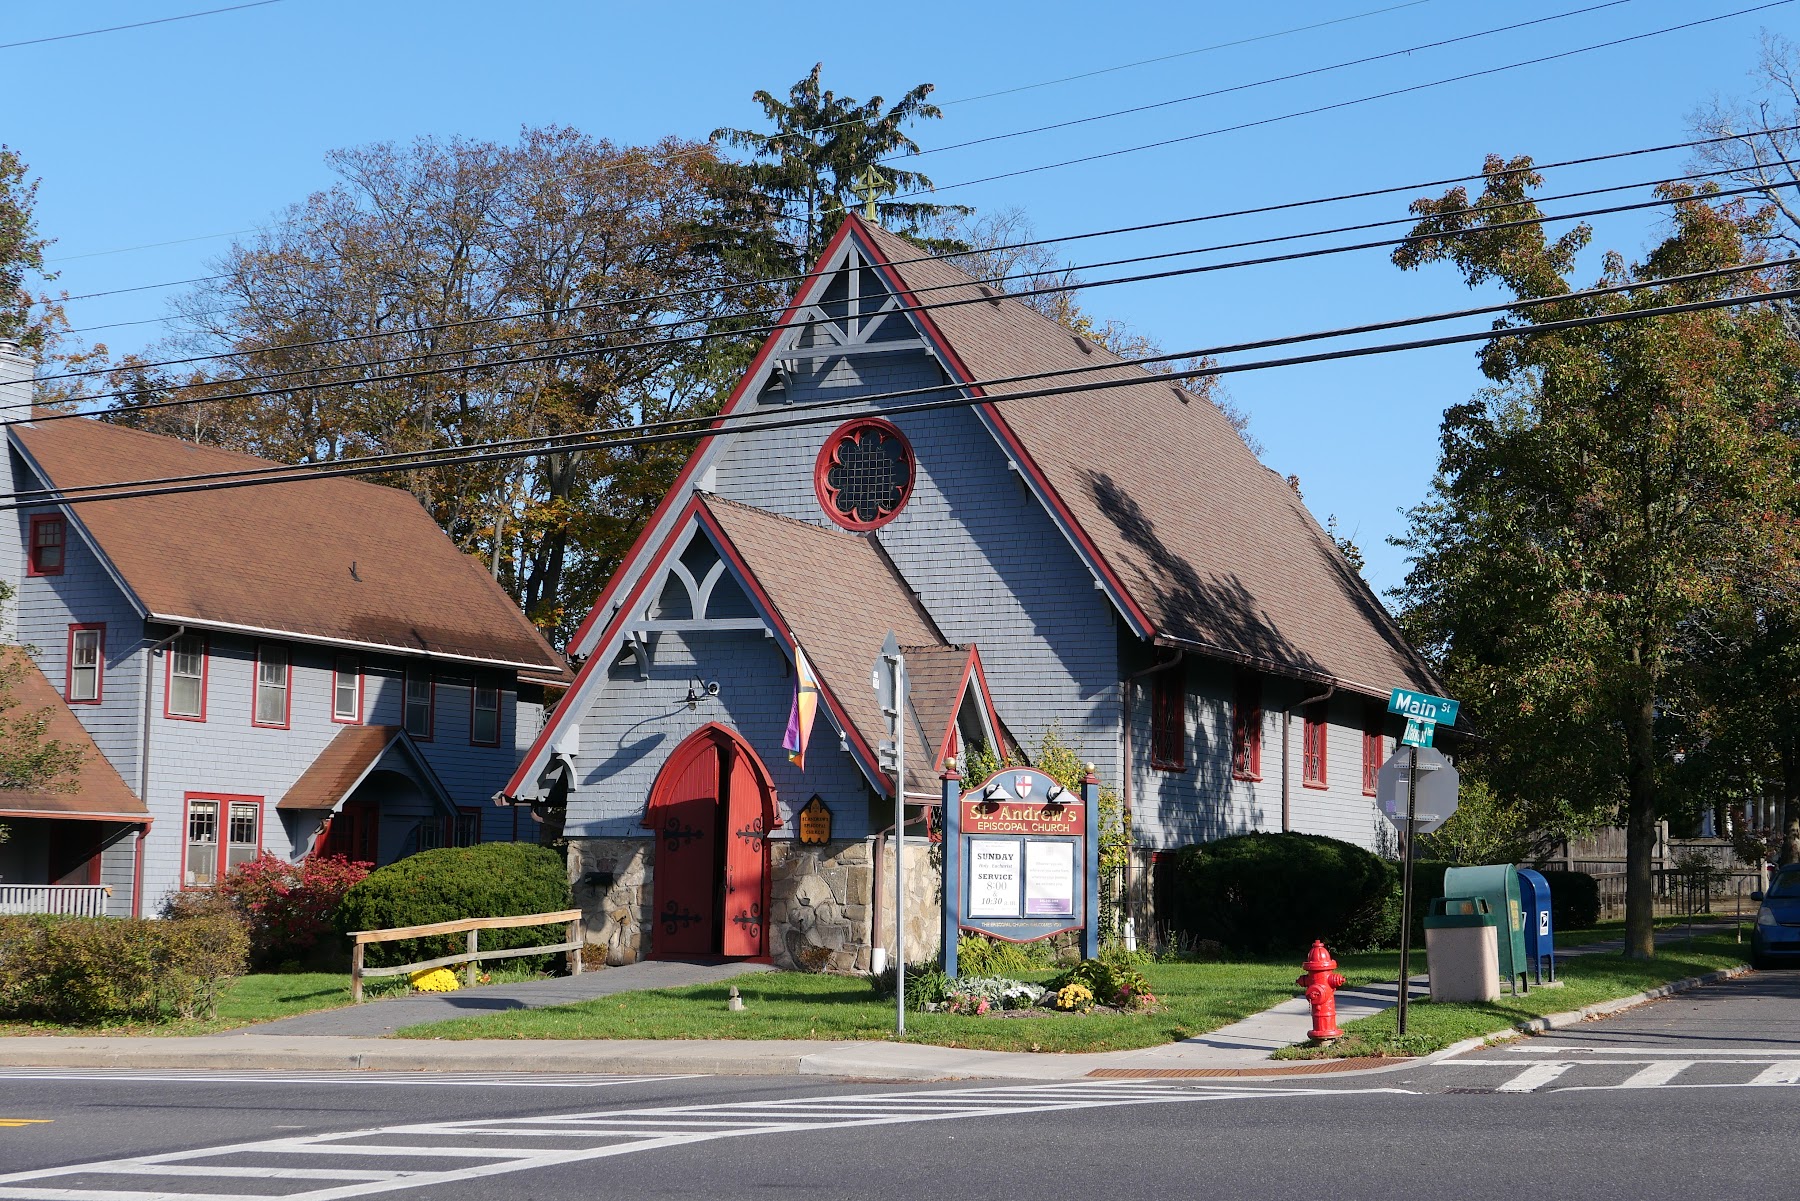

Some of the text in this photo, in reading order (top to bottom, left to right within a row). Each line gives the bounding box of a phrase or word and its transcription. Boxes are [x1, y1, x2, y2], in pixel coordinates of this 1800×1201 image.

[1395, 692, 1451, 718] Main St
[970, 804, 1077, 822] St. Andrew's
[977, 822, 1070, 832] EPISCOPAL CHURCH
[977, 853, 1014, 861] SUNDAY
[987, 881, 1007, 891] 8:00
[982, 897, 1003, 905] 10:30
